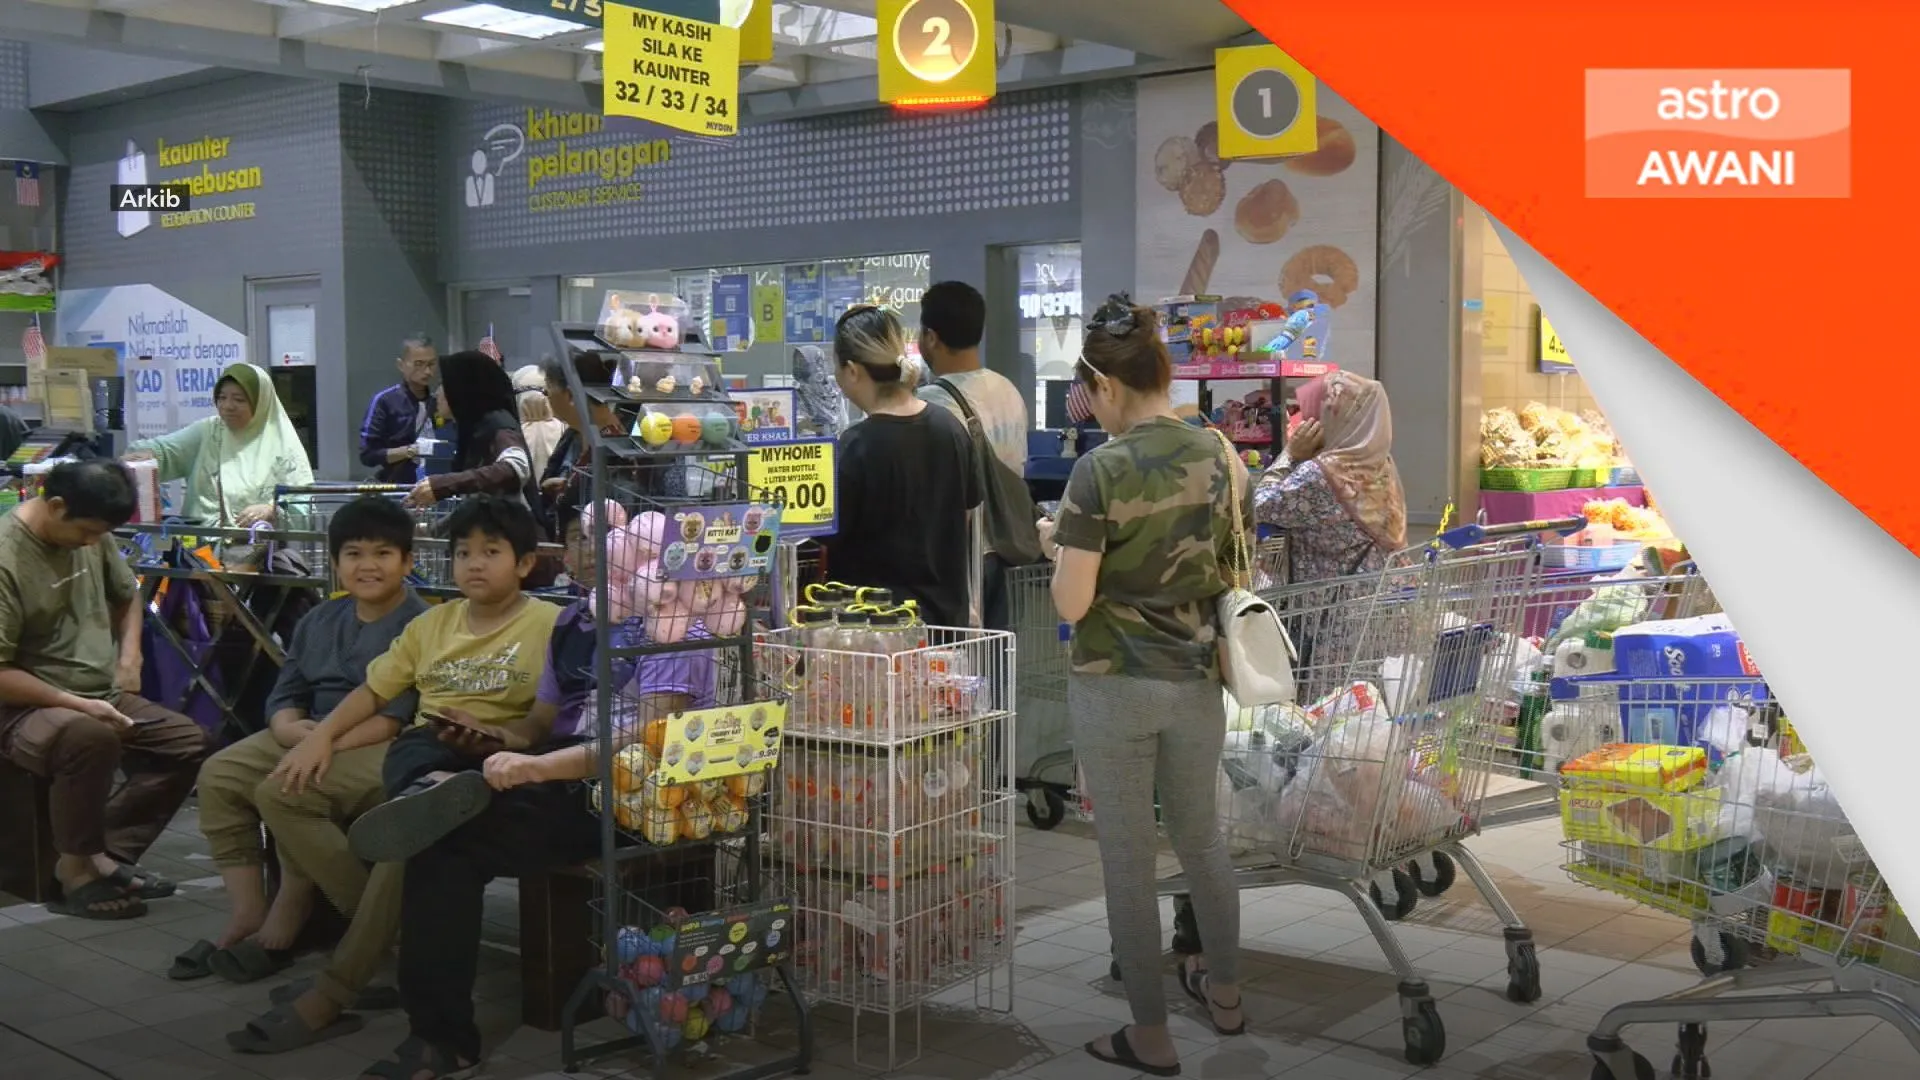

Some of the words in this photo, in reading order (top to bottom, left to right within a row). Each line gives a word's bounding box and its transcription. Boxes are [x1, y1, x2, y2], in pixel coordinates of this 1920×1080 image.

[632, 12, 658, 31] MY
[663, 19, 712, 42] KASIH
[922, 17, 951, 56] 2
[642, 38, 678, 57] SILA
[682, 45, 703, 63] KE
[633, 58, 711, 86] KAUNTER
[615, 80, 641, 104] 32
[661, 88, 685, 111] 33
[705, 96, 728, 117] 34
[1258, 88, 1272, 118] 1
[158, 135, 230, 167] kaunter
[528, 138, 670, 189] pelanggan
[528, 187, 592, 212] CUSTOMER
[594, 182, 642, 204] SERVICE
[128, 309, 189, 336] Nikmatilah
[762, 303, 775, 321] B
[193, 334, 240, 365] dengan
[761, 445, 821, 463] MYHOME
[768, 465, 789, 475] WATER
[791, 464, 816, 473] BOTTLE
[769, 475, 786, 484] LITER
